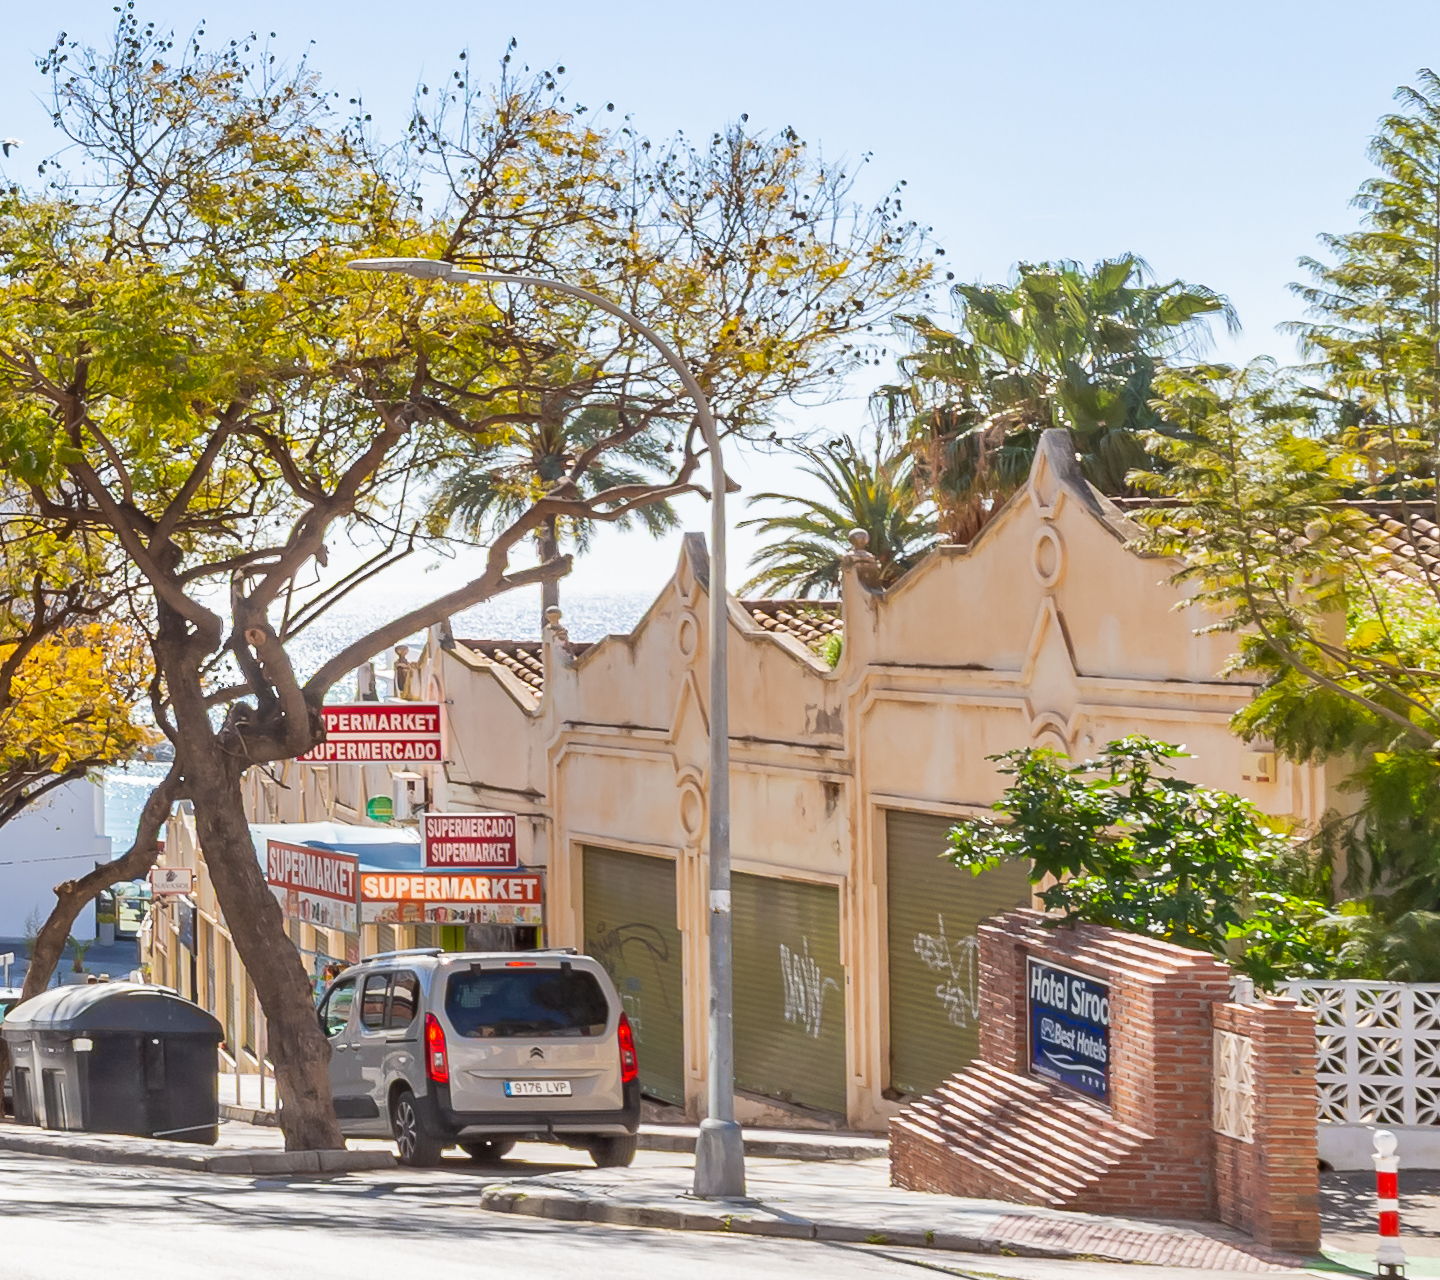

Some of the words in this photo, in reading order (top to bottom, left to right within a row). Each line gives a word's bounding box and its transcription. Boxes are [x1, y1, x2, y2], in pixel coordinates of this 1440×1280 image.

[322, 714, 437, 732] PERMARKET
[427, 818, 514, 839] SUPERMERCADO
[431, 842, 511, 863] SUPERMARKET
[269, 846, 355, 897] SUPERMARKET
[364, 877, 538, 900] SUPERMARKET
[1031, 966, 1068, 1010] Hotel
[1070, 980, 1110, 1025] Siroc
[1054, 1022, 1075, 1051] Best
[1077, 1031, 1107, 1062] Hotels
[514, 1082, 542, 1093] 9176
[546, 1082, 567, 1093] LVP
